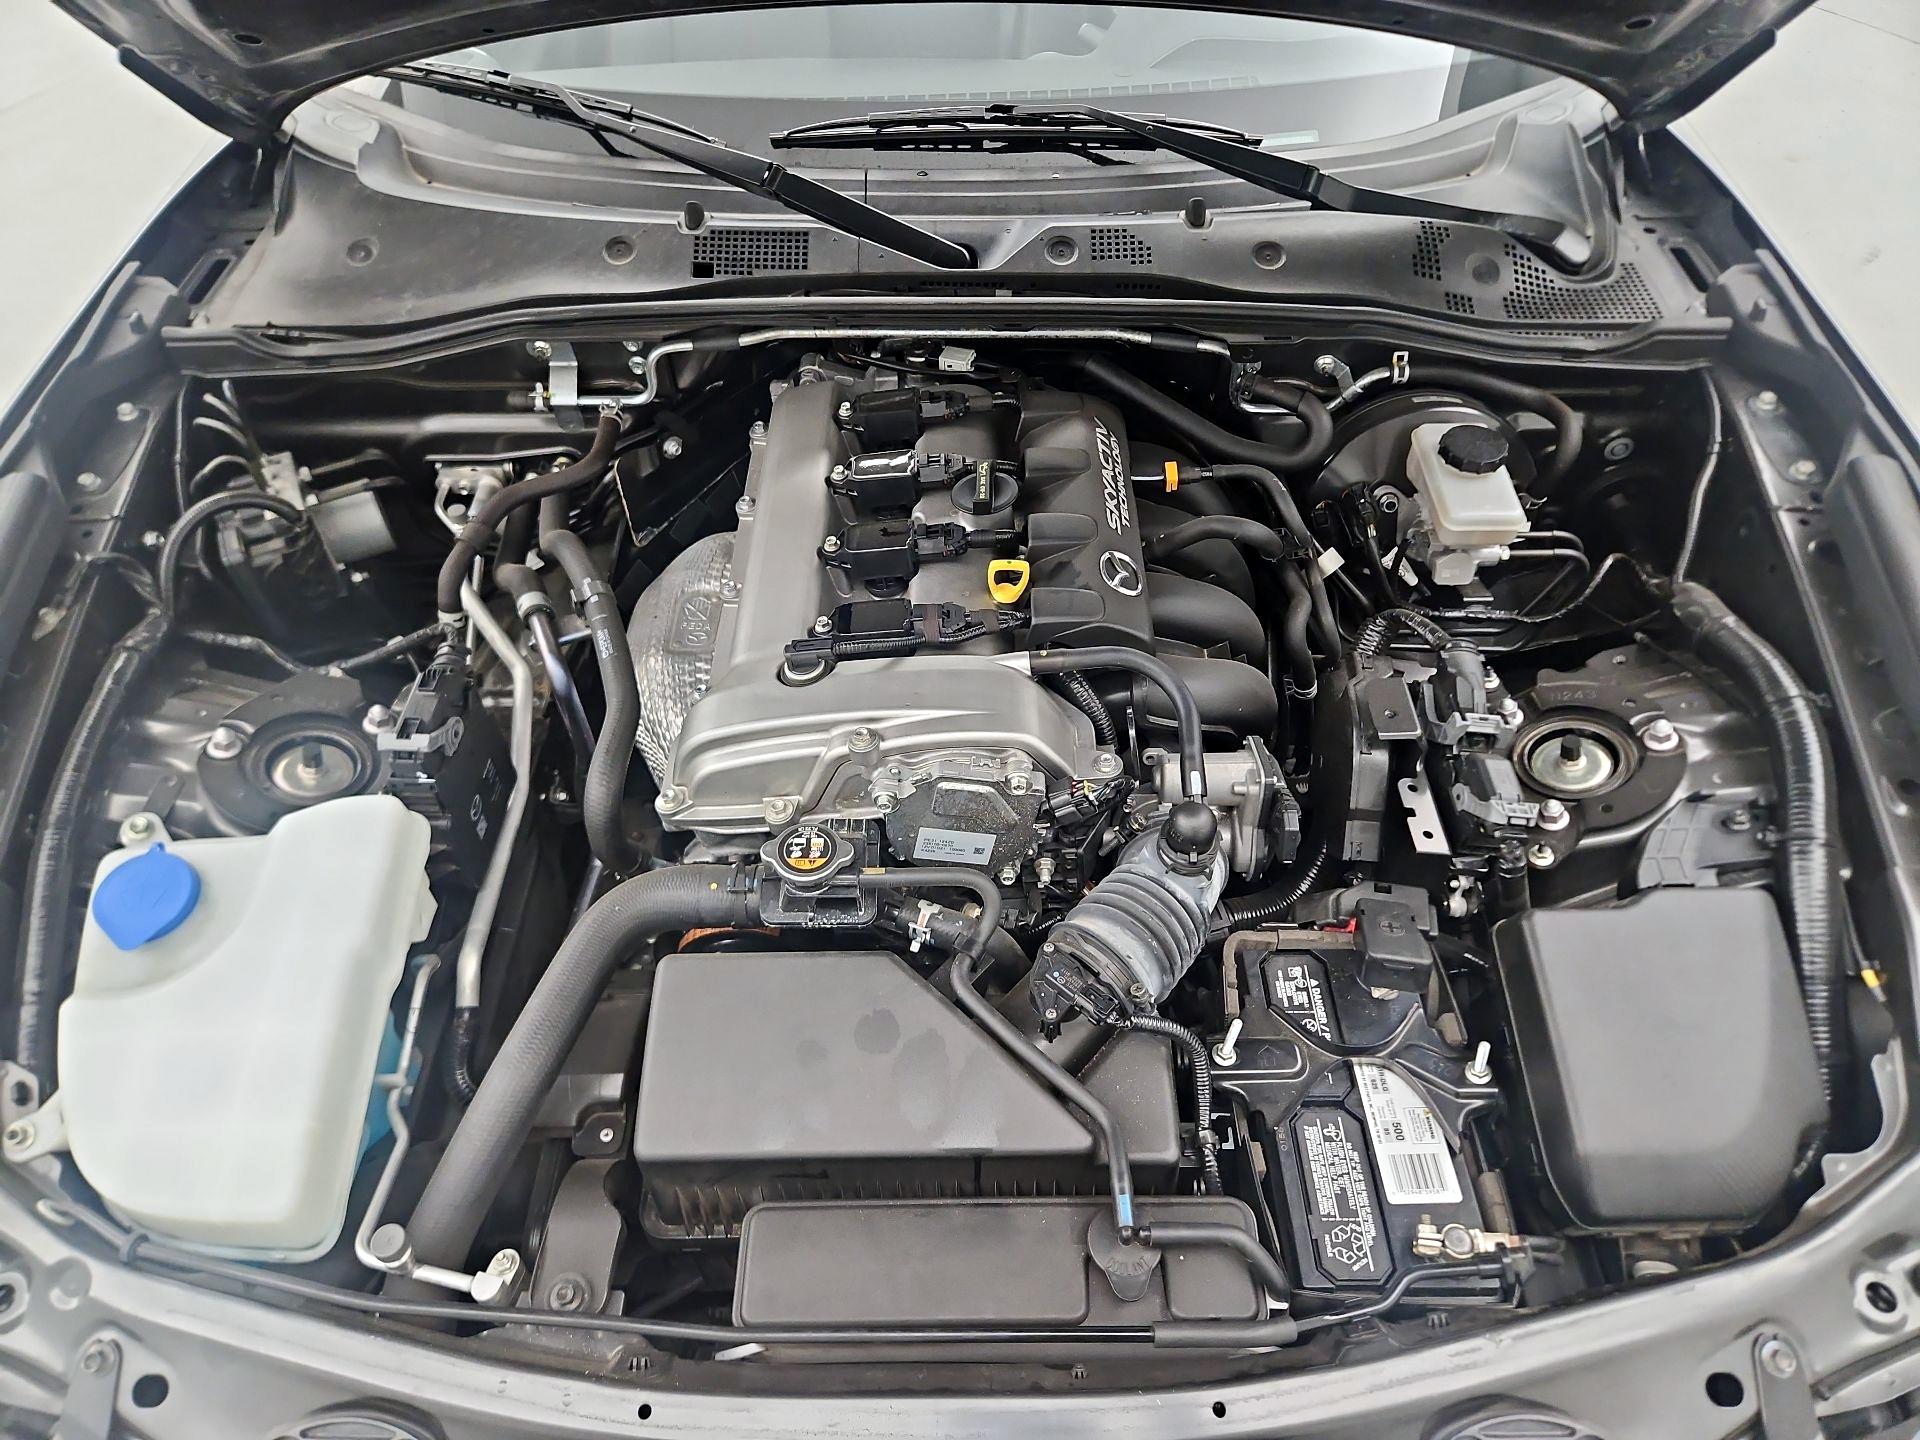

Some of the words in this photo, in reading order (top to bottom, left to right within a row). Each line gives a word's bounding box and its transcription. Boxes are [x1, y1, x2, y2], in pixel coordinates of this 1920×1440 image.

[1094, 416, 1122, 535] SKYACTIV
[1109, 431, 1131, 528] TECHNOLOGY
[1312, 988, 1327, 1024] DANGER
[1392, 1122, 1405, 1141] 500
[1333, 1181, 1341, 1194] FAST
